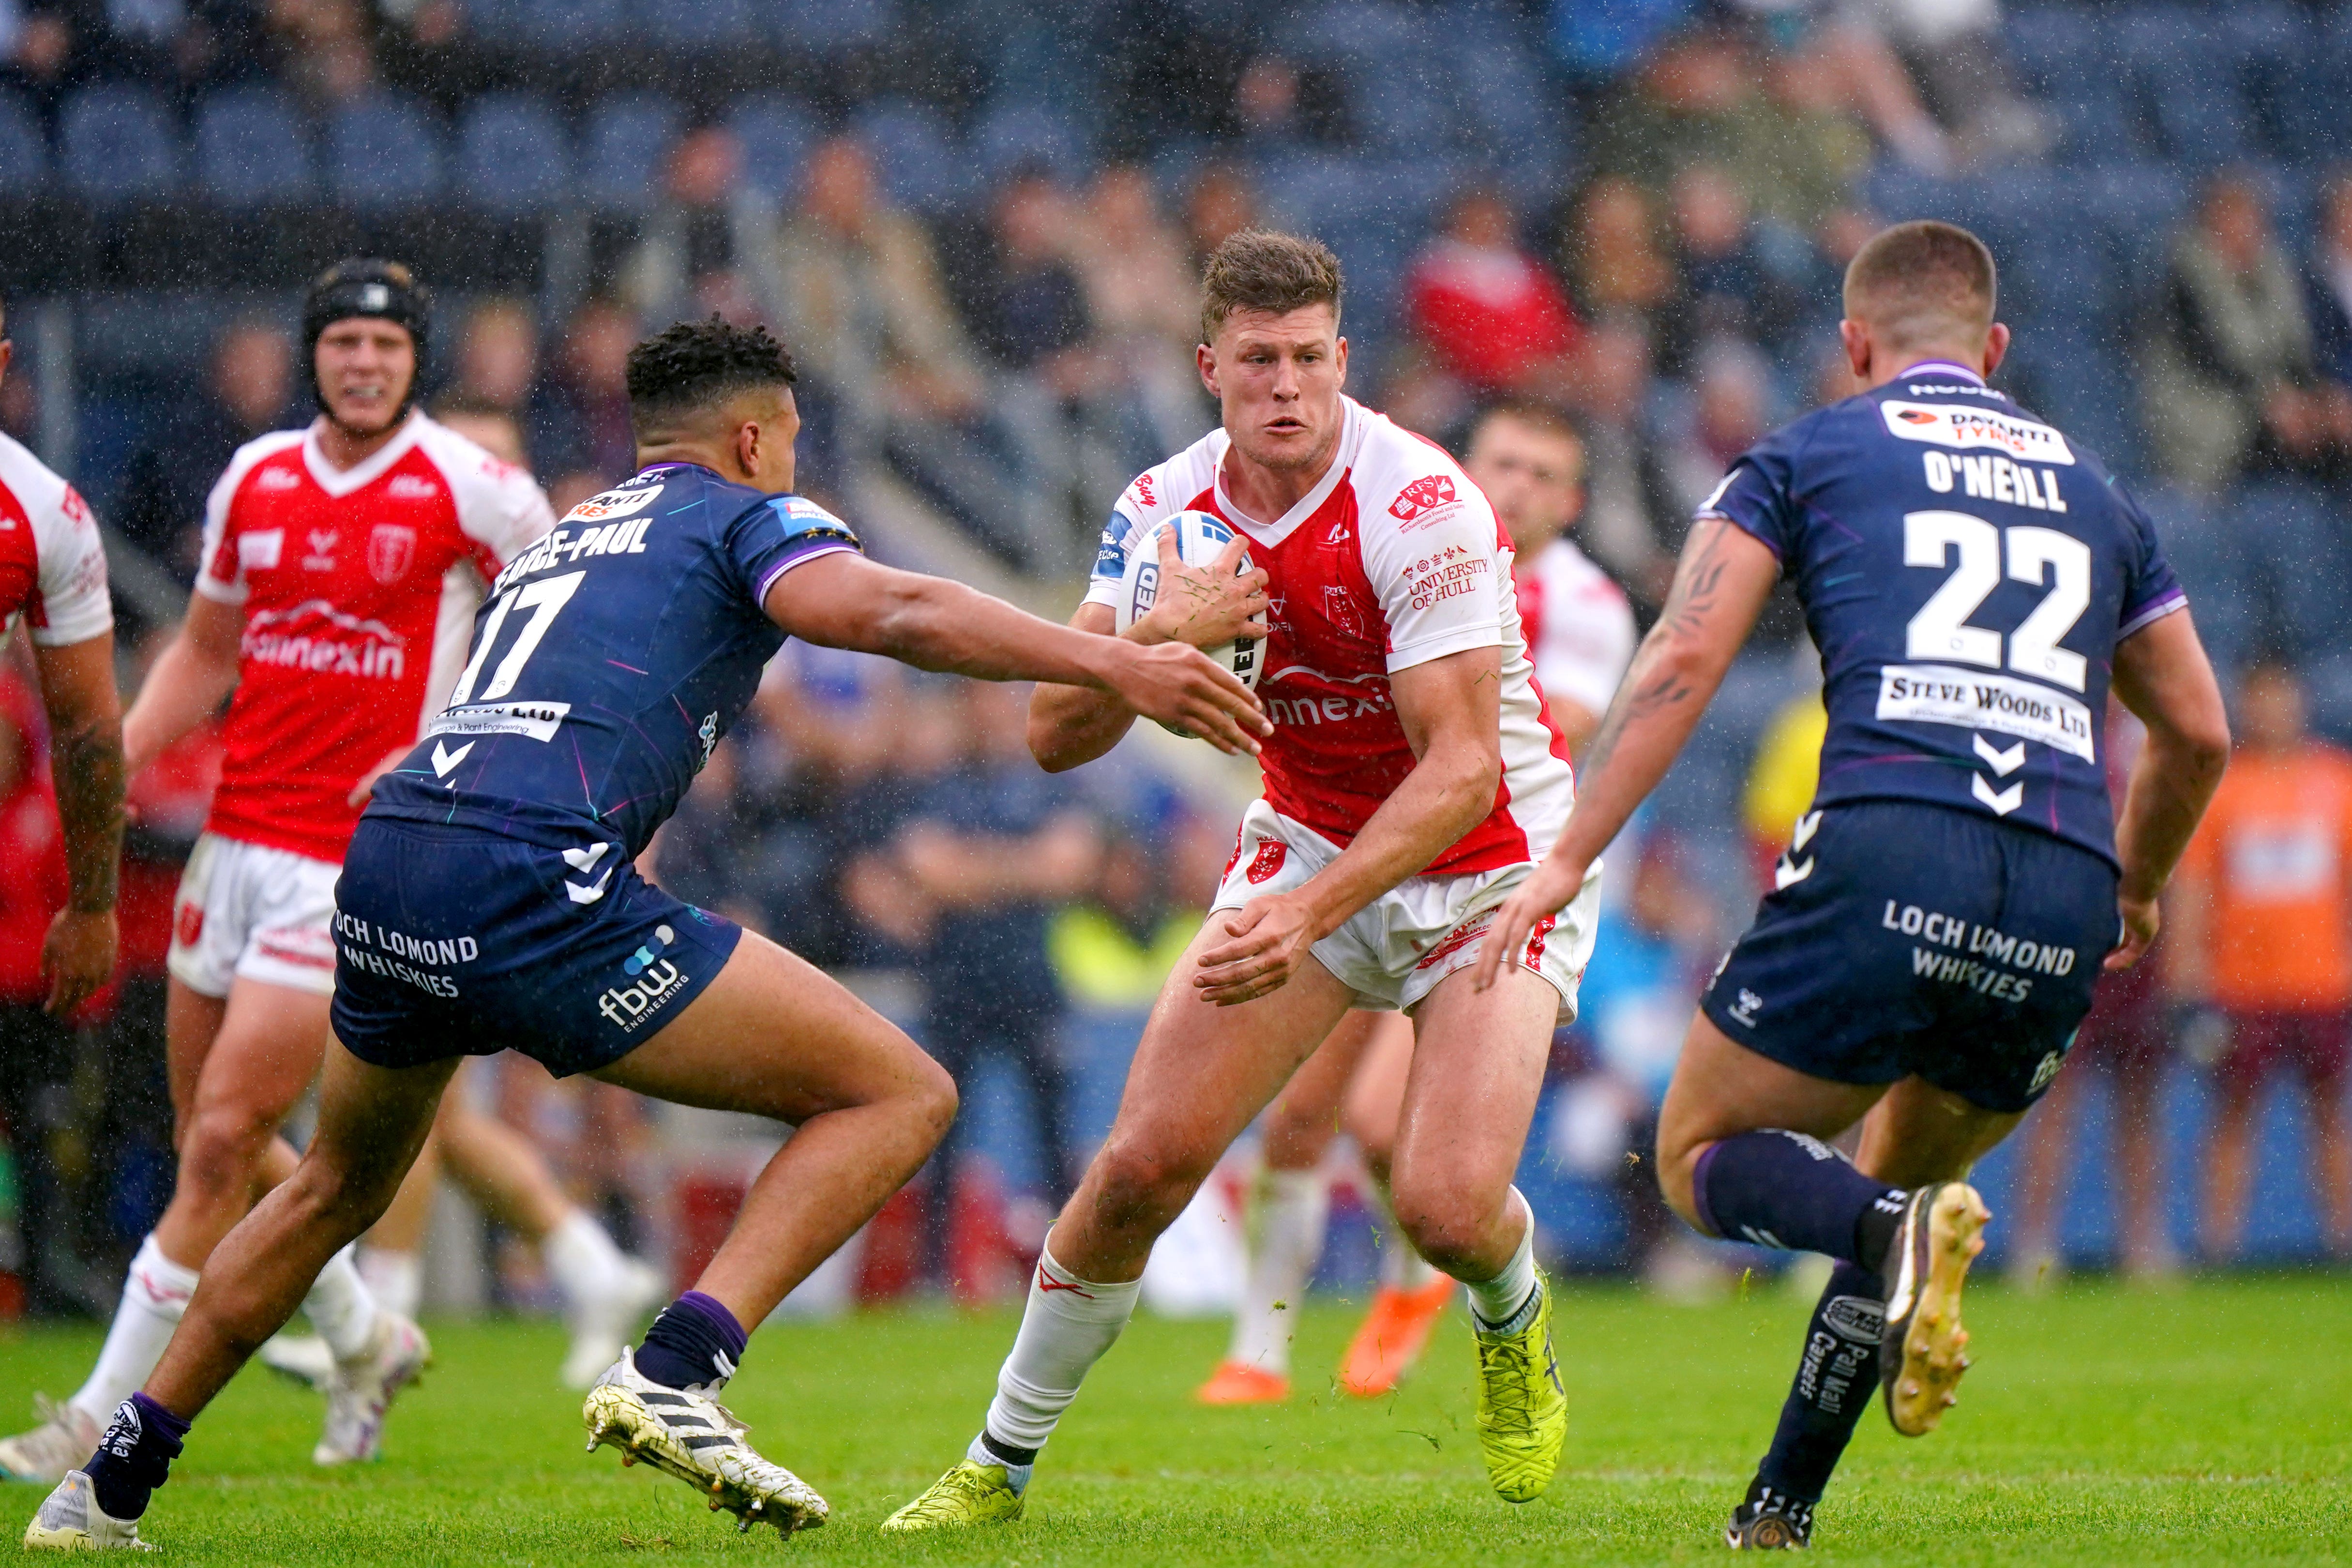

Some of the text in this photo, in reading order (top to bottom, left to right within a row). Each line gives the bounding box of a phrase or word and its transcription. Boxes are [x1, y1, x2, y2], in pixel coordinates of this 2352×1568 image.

[1405, 479, 1434, 498] RFS
[1923, 450, 2067, 513] O'NEILL
[571, 505, 613, 517] RES
[1420, 515, 1447, 530] Consulting
[1432, 508, 1444, 517] Food
[492, 518, 653, 598] EARCE-PAUL
[1408, 559, 1487, 596] UNIVERSITY
[1412, 578, 1476, 610] OF HULL
[1903, 510, 2091, 693] 22
[448, 570, 587, 708] 17
[1889, 678, 1966, 703] STEVE
[1974, 685, 2052, 722] WOODS
[464, 723, 482, 731] Plant
[483, 723, 529, 734] Engineering
[336, 909, 479, 965] OCH LOMOND
[1882, 898, 1966, 950] LOCH
[344, 944, 459, 998] WHISKIES
[598, 958, 678, 1026] fbw
[623, 974, 690, 1033] ENGINEERING
